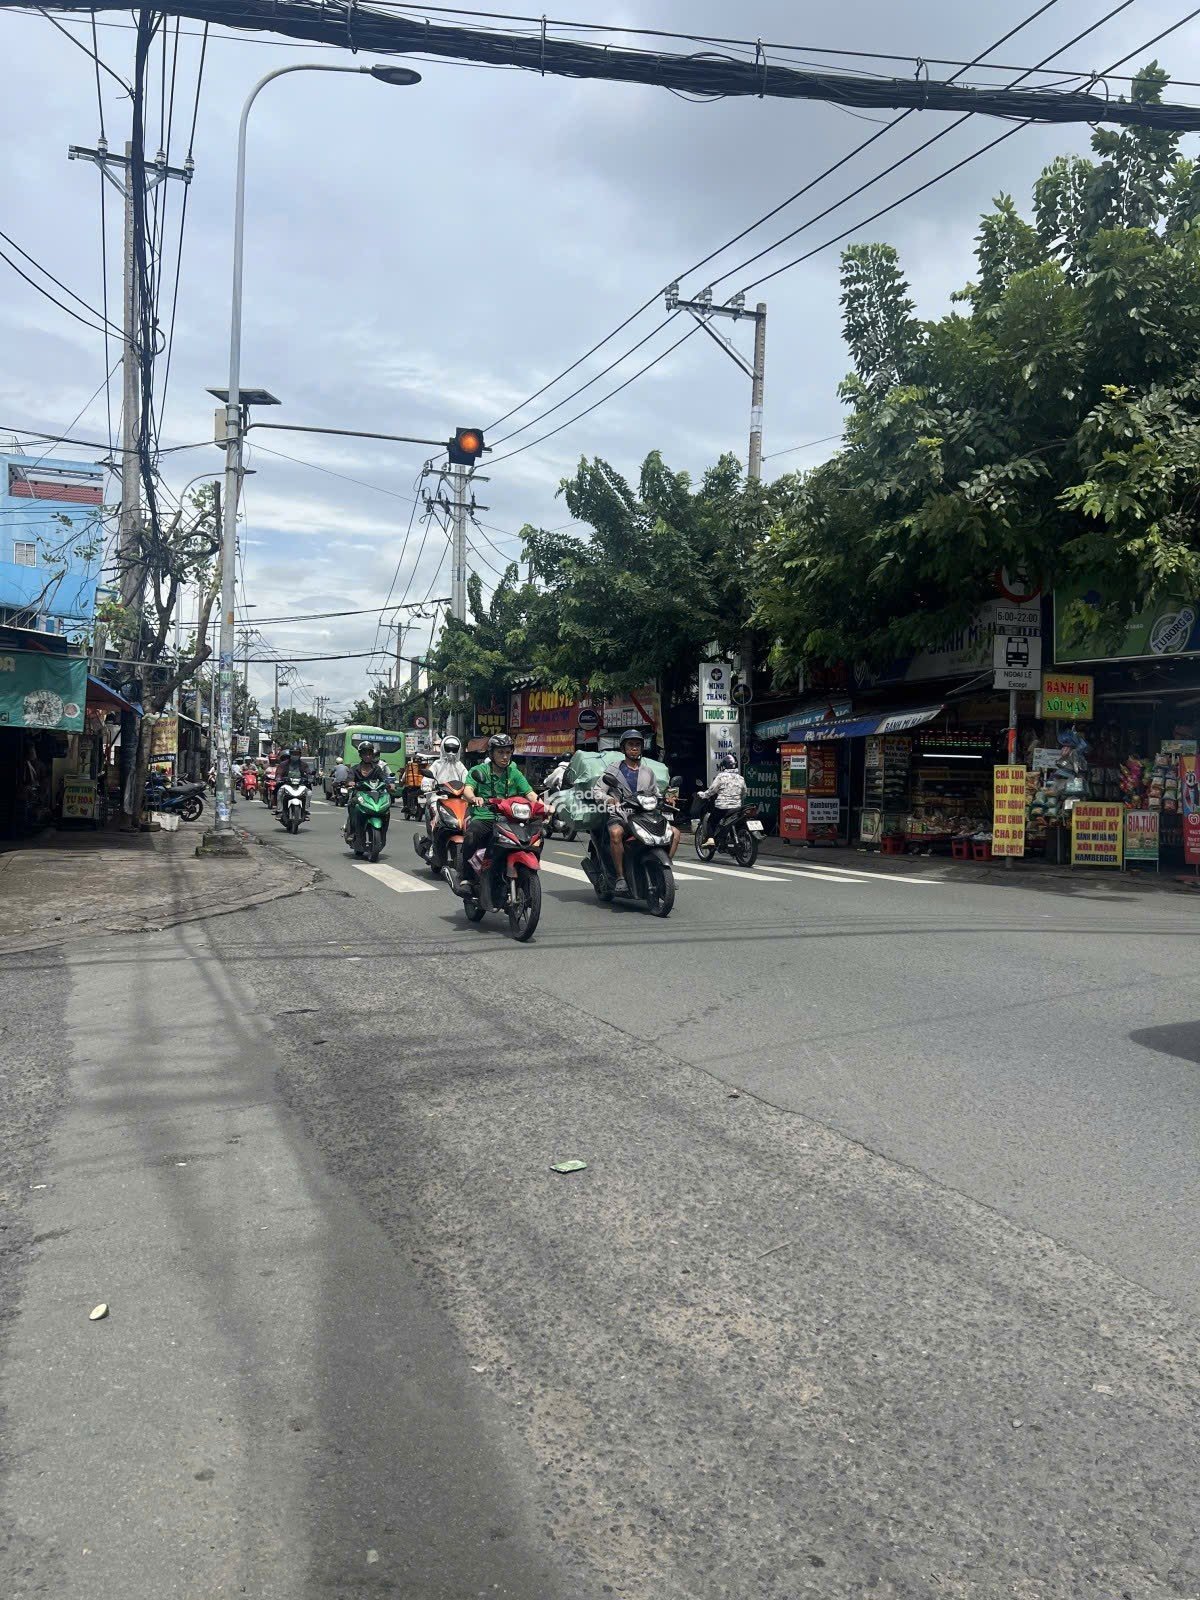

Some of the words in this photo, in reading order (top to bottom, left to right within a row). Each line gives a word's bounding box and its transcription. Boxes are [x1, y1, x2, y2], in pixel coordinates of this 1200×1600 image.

[997, 611, 1038, 623] 6:00-22:00
[1153, 617, 1187, 651] TUBORG
[709, 682, 724, 690] MINH
[1047, 679, 1075, 693] BÁNH
[1077, 680, 1089, 695] MÌ
[706, 690, 727, 701] THẮNG
[1046, 696, 1063, 711] XÔI
[704, 707, 725, 720] THUỐC
[727, 709, 738, 720] TÂY
[718, 739, 733, 749] NHÀ
[757, 770, 778, 782] NHÀ
[747, 784, 778, 797] THUỐC
[810, 801, 838, 809] Hamburger
[1075, 805, 1102, 816] BÁNH
[1105, 806, 1119, 817] MÌ
[1128, 815, 1139, 832] BIA
[1075, 854, 1117, 862] HAMBERGER
